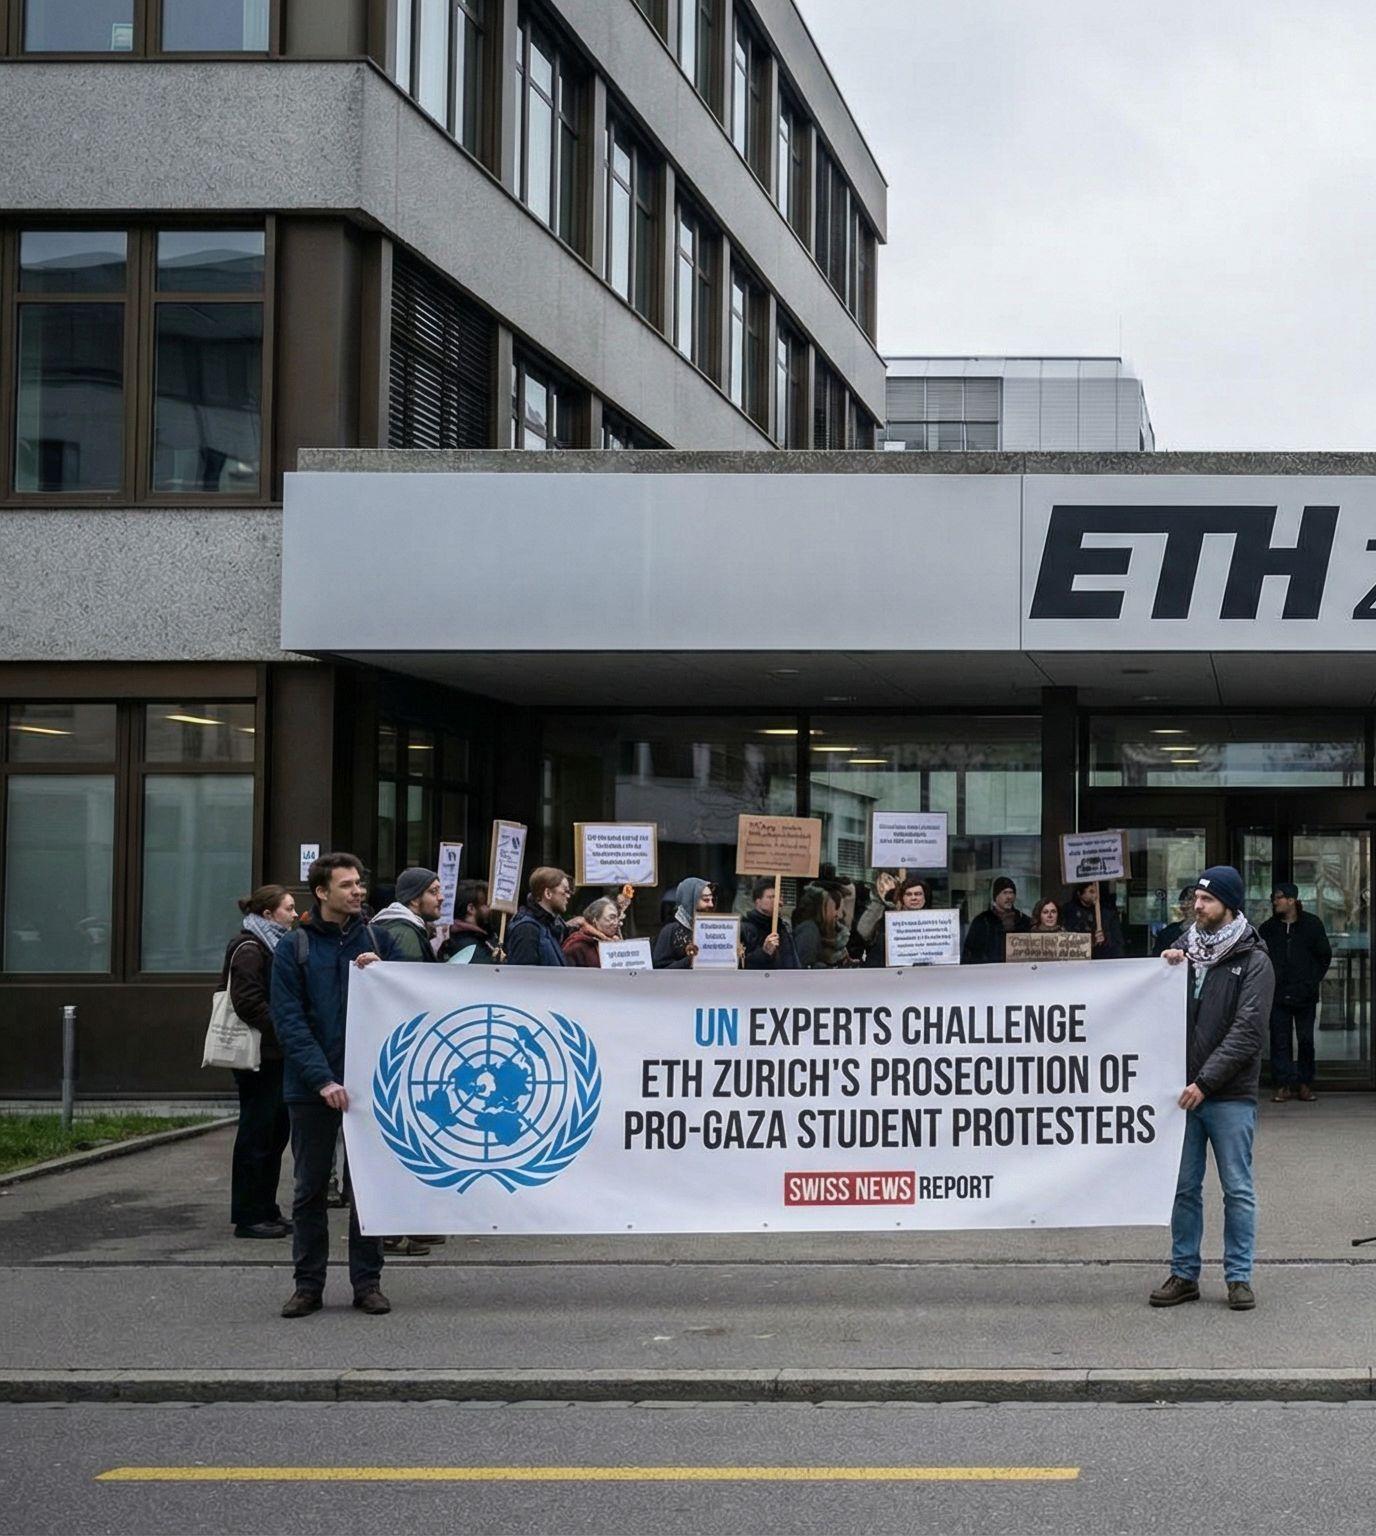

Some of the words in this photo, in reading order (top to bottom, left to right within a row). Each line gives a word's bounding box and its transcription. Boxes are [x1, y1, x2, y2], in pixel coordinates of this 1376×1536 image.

[1029, 505, 1341, 620] ETH
[695, 1007, 739, 1047] UN
[749, 1006, 892, 1046] EXPERTS
[902, 1004, 1087, 1045] CHALLENGE
[642, 1059, 703, 1098] ETH
[712, 1058, 860, 1098] ZURICH'S
[870, 1055, 1089, 1097] PROSECUTION
[1100, 1054, 1139, 1094] OF
[624, 1110, 787, 1150] PRO-GAZA
[797, 1108, 943, 1149] STUDENT
[952, 1104, 1156, 1147] PROTESTERS
[788, 1177, 851, 1202] SWISS
[855, 1176, 912, 1201] NEWS
[919, 1175, 994, 1200] REPORT
